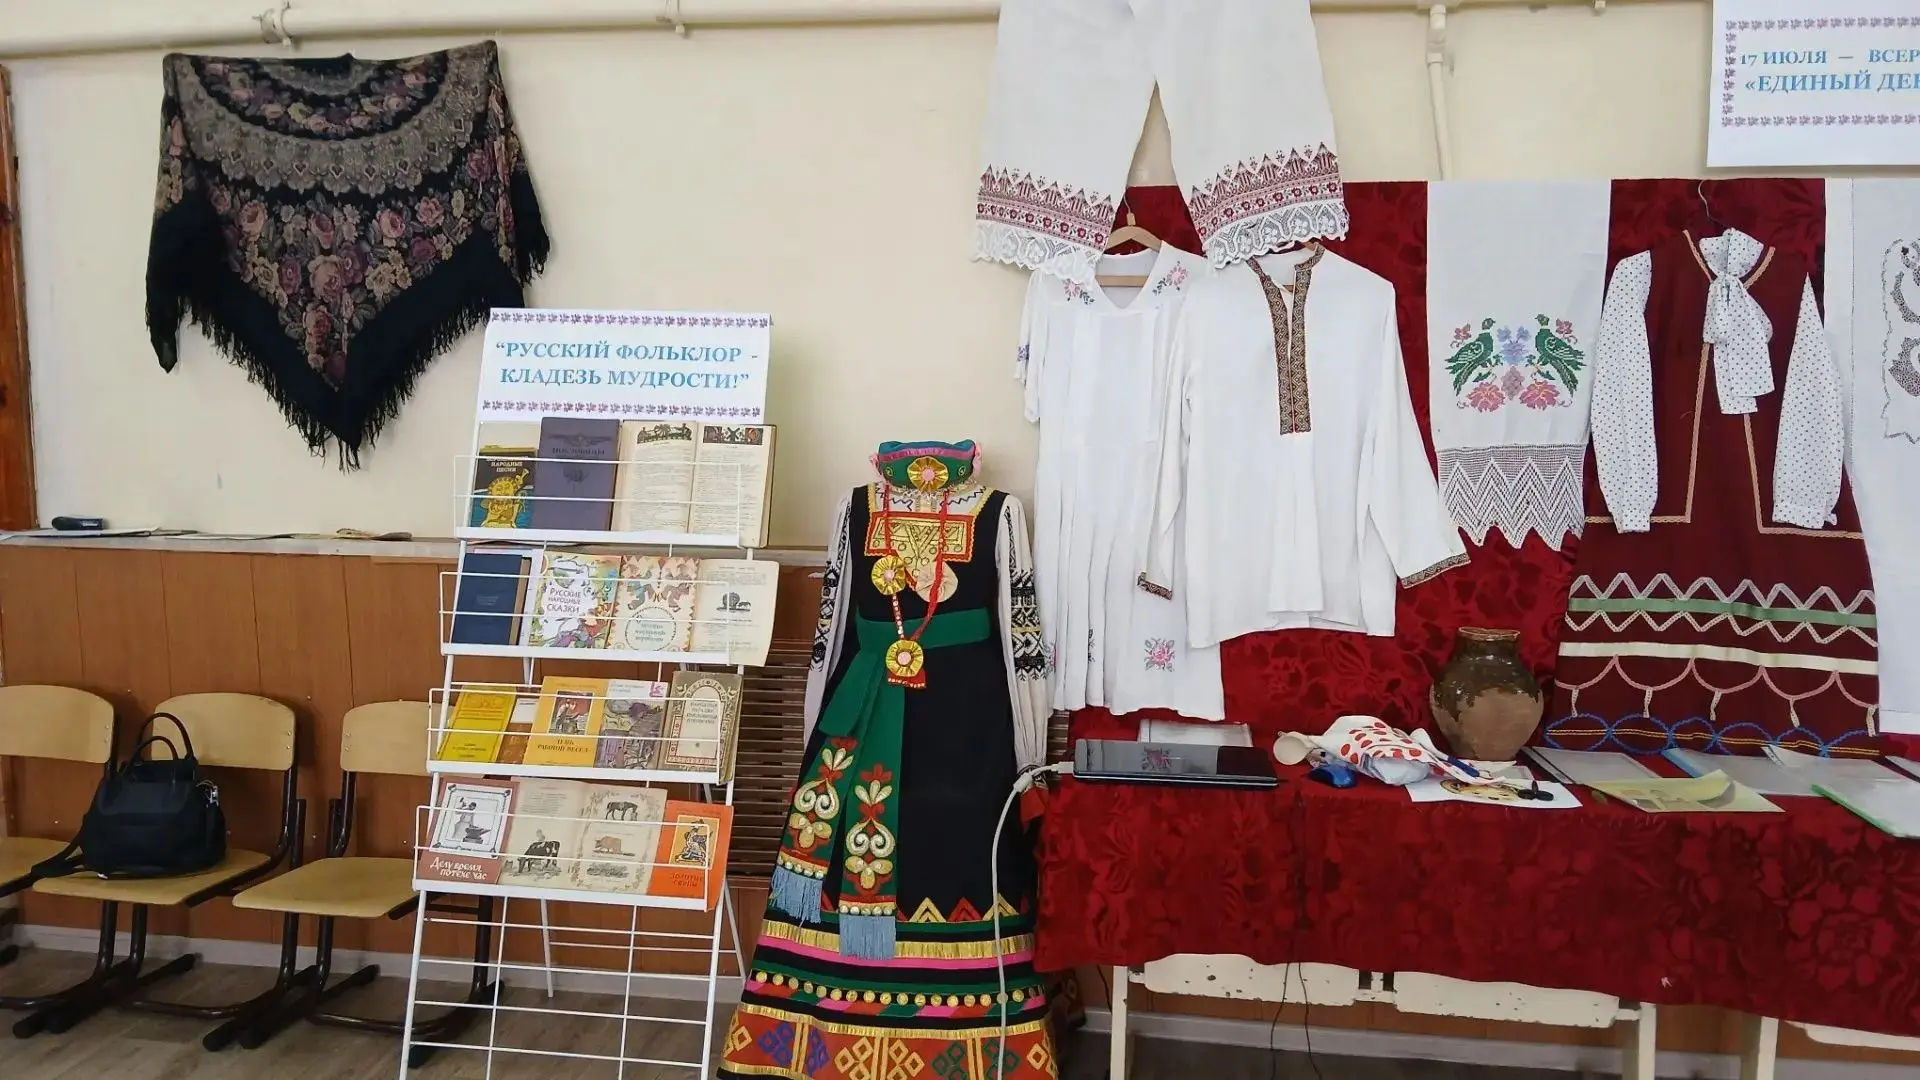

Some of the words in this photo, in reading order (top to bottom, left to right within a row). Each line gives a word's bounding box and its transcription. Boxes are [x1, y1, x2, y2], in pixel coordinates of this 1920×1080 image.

[1740, 54, 1757, 67] 17
[1762, 50, 1827, 65] ИЮЛЯ
[1868, 49, 1920, 63] ВСЕР
[1745, 69, 1871, 94] «ЕДИНЫЙ
[496, 340, 611, 359] “РУССКИЙ
[616, 346, 742, 363] ФОЛЬКЛОР
[500, 368, 601, 386] КЛАДЕЗЬ
[607, 370, 749, 389] МУДРОСТИ!”
[546, 603, 580, 614] СКАЗКИ
